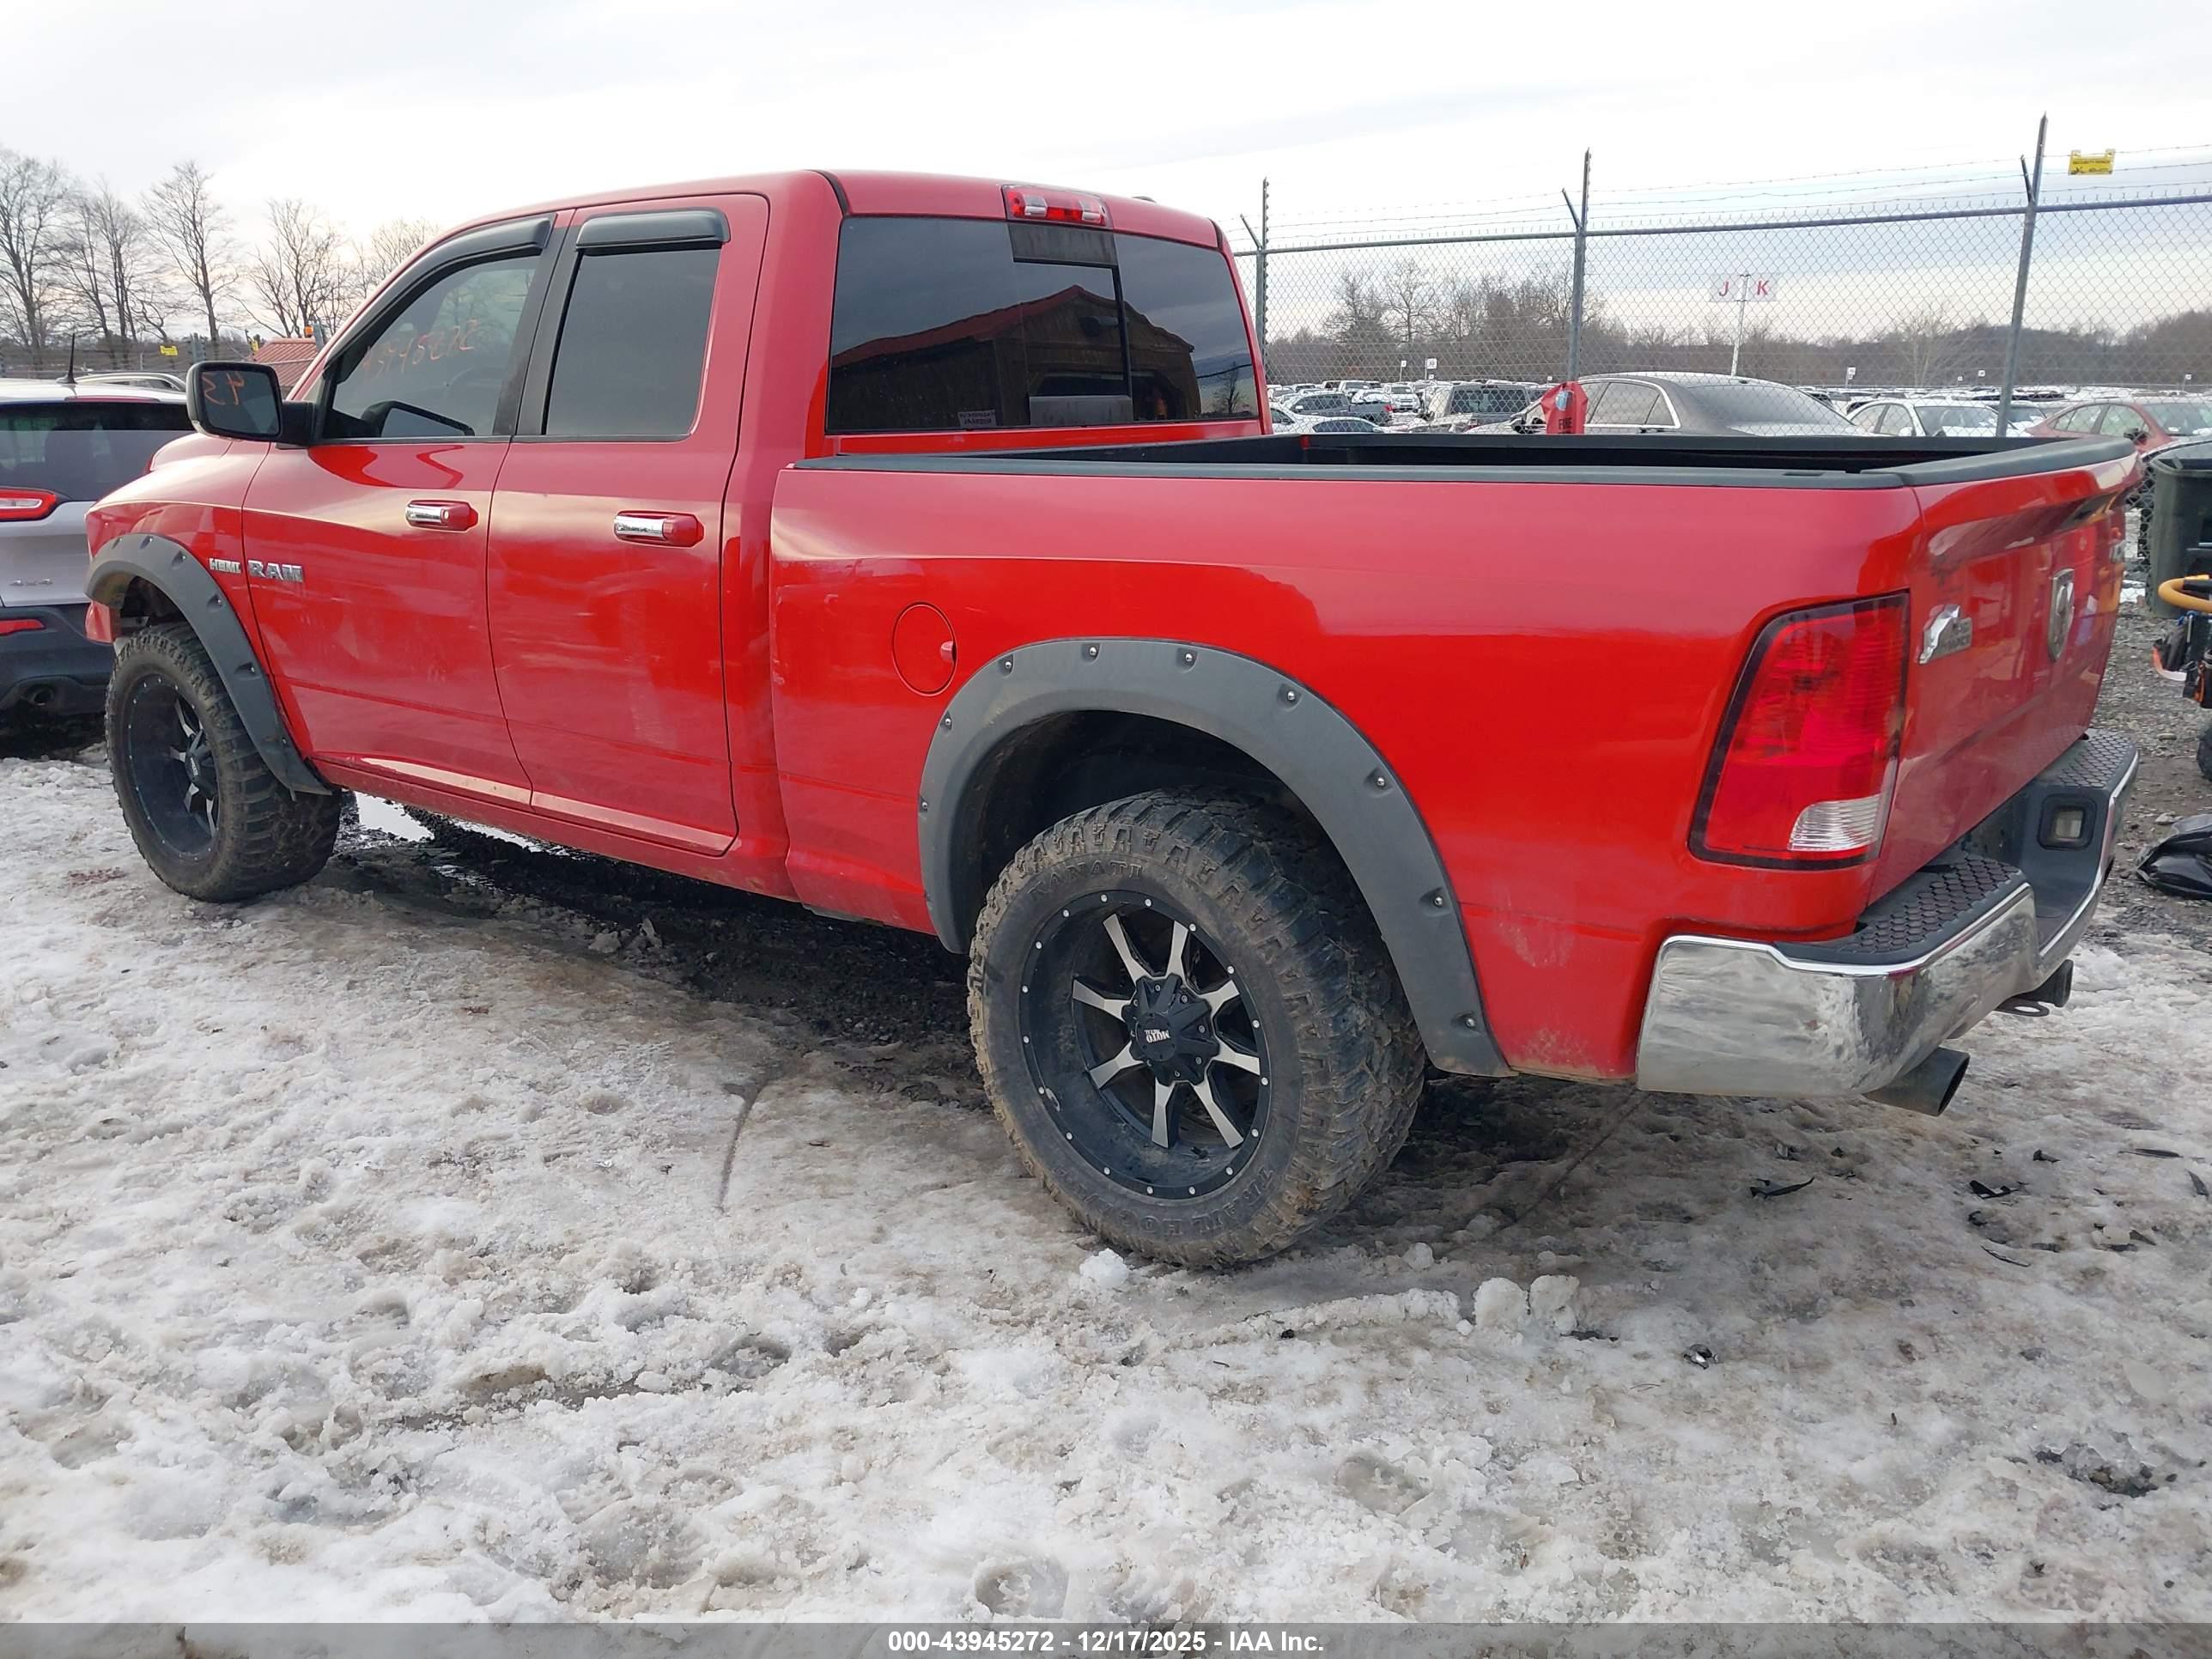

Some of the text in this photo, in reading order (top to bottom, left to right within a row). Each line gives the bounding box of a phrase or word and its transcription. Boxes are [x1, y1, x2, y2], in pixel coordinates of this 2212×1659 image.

[1718, 281, 1729, 297] J
[1756, 280, 1770, 296] K
[209, 557, 241, 574] HEMI
[247, 559, 304, 583] RAM
